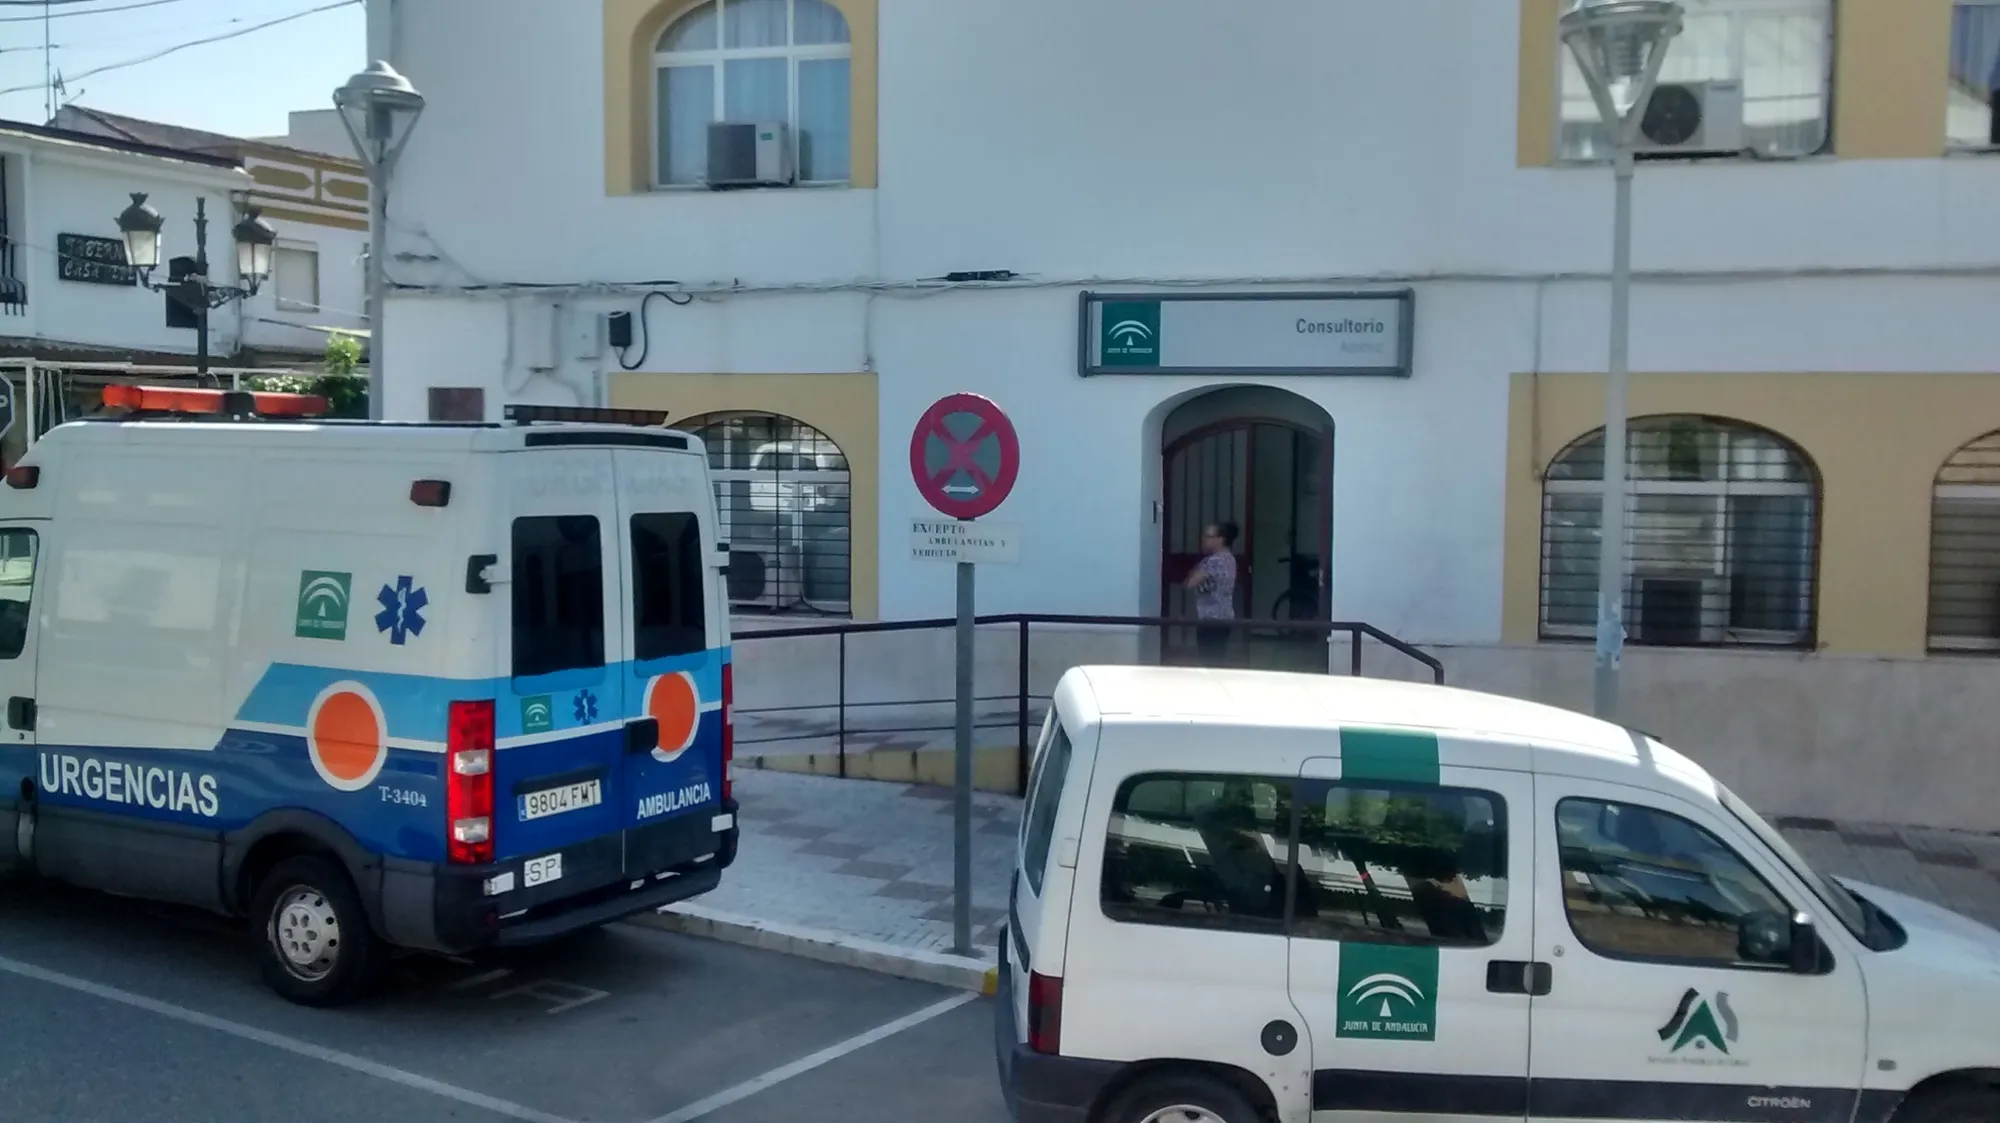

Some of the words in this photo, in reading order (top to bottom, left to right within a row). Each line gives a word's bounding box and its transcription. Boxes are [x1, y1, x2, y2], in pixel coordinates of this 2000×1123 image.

[1296, 317, 1385, 334] Consultorio
[913, 523, 965, 534] EXCEPTO
[928, 537, 995, 547] AMBULANCIAS
[40, 752, 219, 817] URGENCIAS
[378, 785, 428, 807] T-3404
[529, 789, 568, 815] 9804
[571, 781, 597, 807] FMT
[636, 781, 712, 820] AMBULANCIA
[529, 857, 557, 882] SP
[1343, 1020, 1369, 1031] JUNTA
[1372, 1021, 1382, 1032] DE
